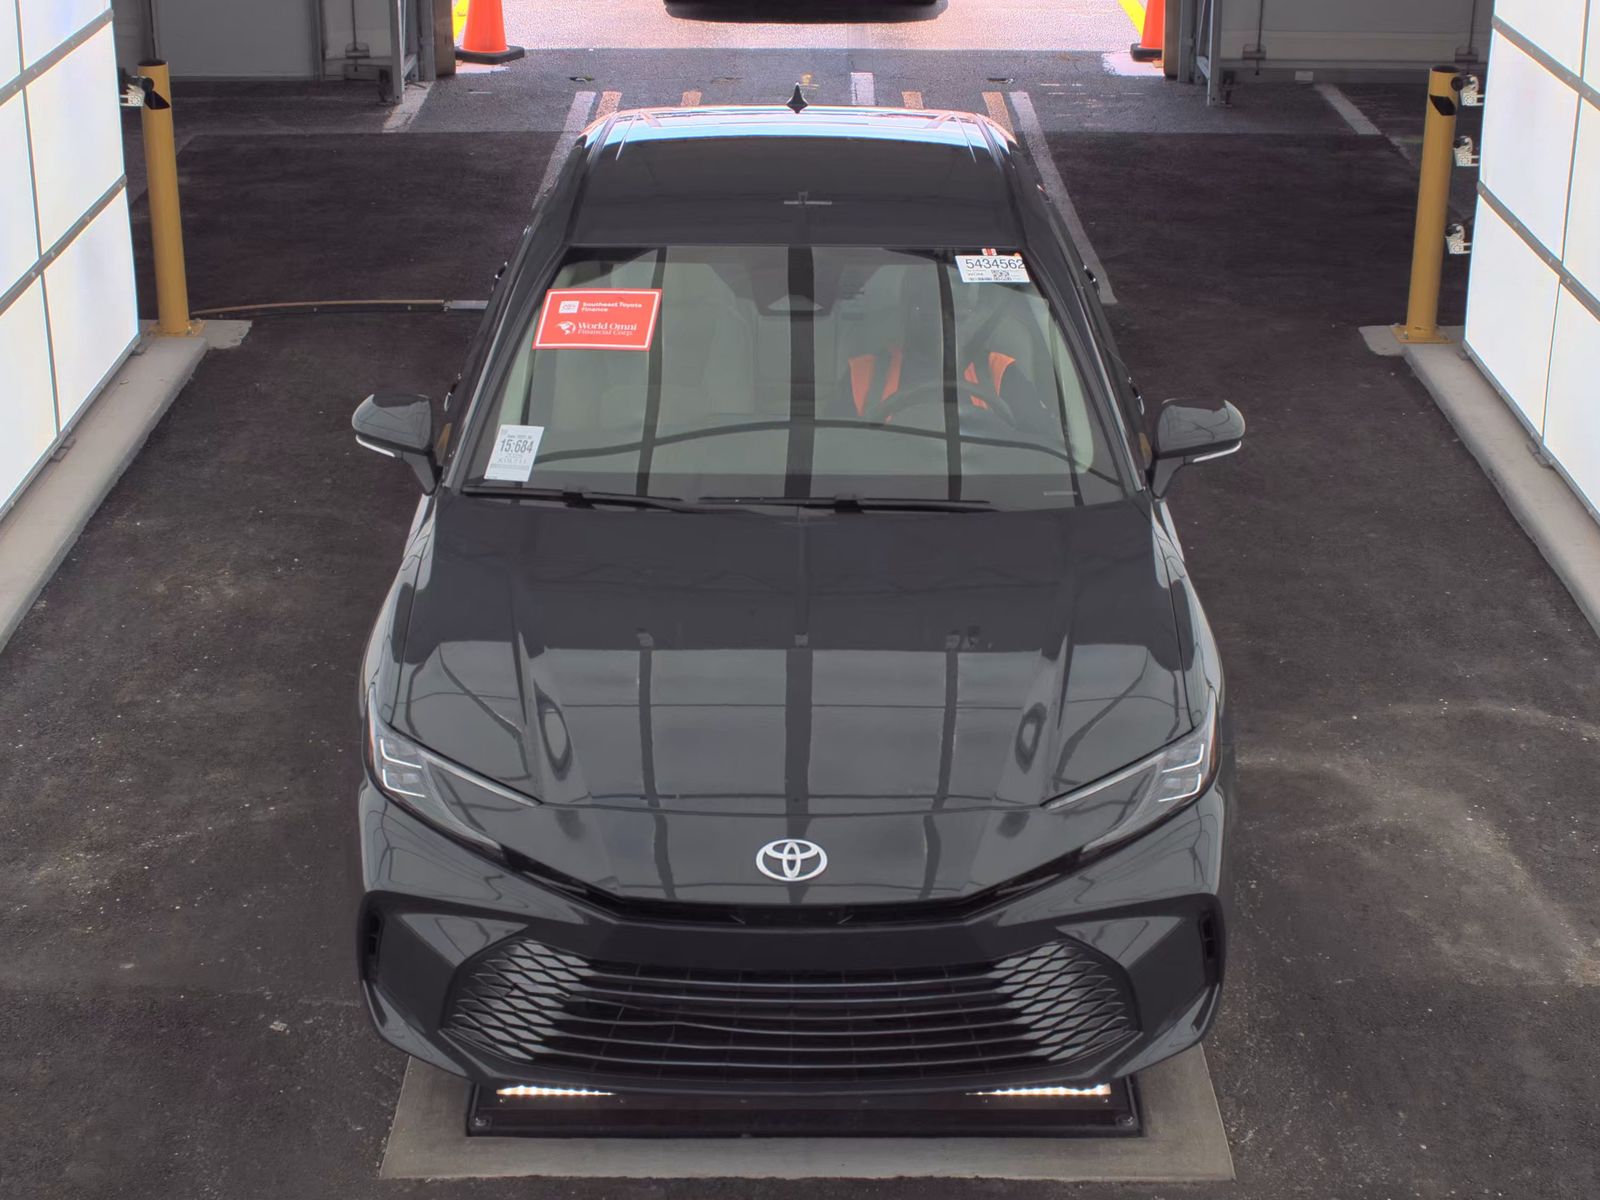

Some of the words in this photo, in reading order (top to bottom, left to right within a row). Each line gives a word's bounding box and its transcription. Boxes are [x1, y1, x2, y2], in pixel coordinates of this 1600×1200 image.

[965, 258, 1025, 269] 5434562
[578, 322, 608, 330] World
[609, 323, 637, 331] Omni
